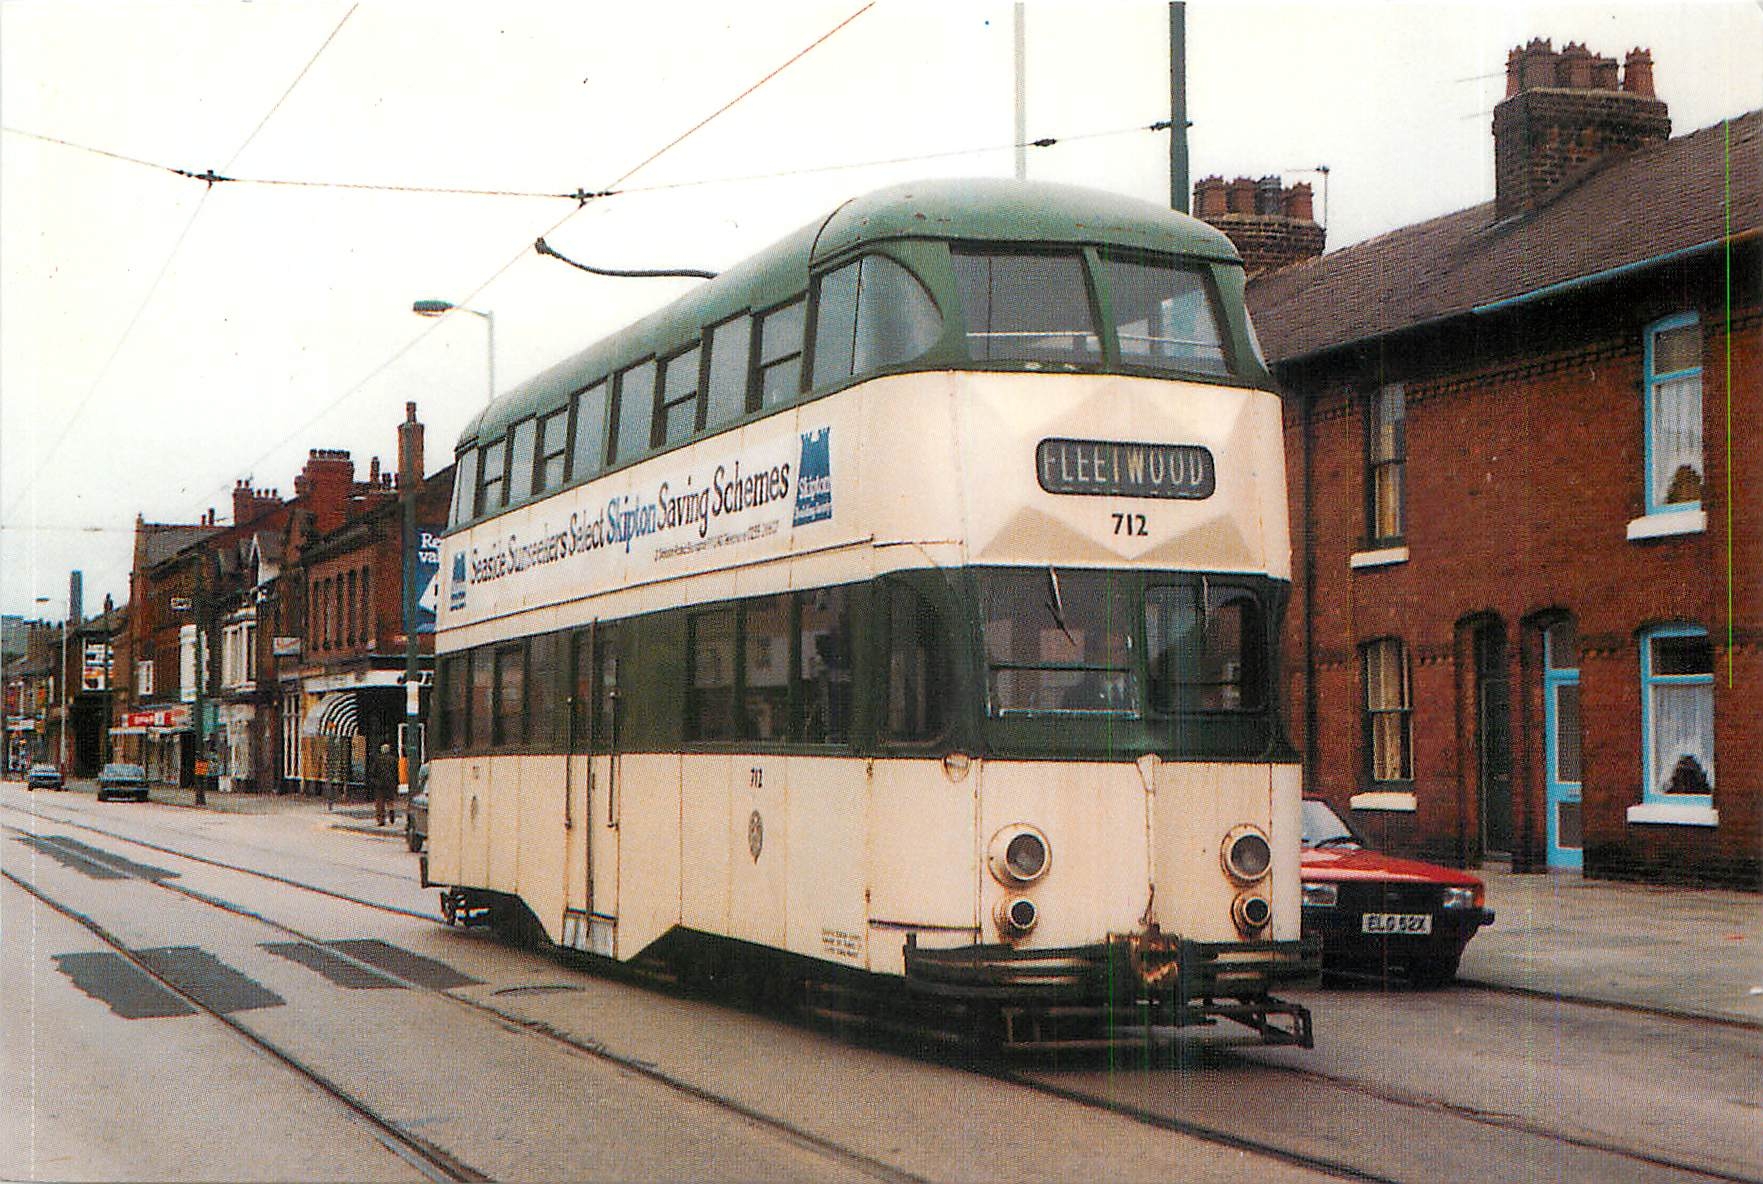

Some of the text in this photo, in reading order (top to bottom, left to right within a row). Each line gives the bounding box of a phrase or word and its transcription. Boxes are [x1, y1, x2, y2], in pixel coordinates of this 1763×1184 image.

[568, 510, 605, 556] Select
[606, 494, 657, 554] Skipton
[656, 474, 711, 539] Saving
[711, 460, 791, 517] Schemes
[1111, 513, 1149, 537] 712
[421, 533, 440, 549] Re
[750, 767, 763, 789] 712
